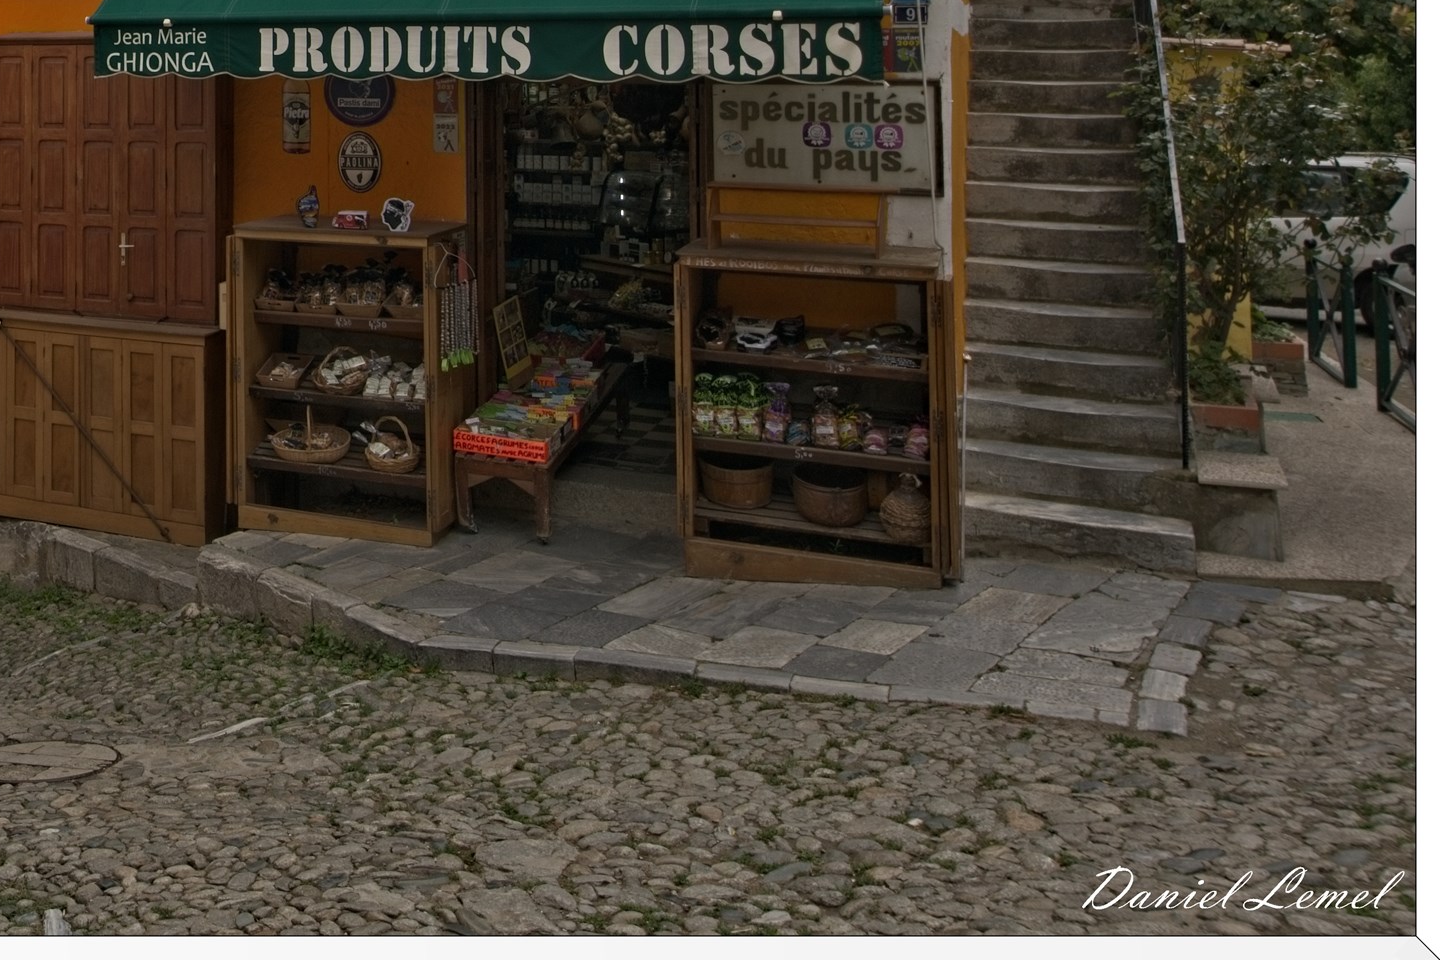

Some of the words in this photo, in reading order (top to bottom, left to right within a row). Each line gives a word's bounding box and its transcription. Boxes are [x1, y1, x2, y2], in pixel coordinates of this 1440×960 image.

[905, 7, 916, 21] 9
[113, 28, 155, 46] Jean
[157, 28, 208, 46] Marie
[258, 25, 532, 76] PRODUITS
[603, 21, 864, 77] CORSES
[106, 51, 215, 73] GHIONGA
[719, 91, 927, 131] spécialités
[340, 157, 379, 168] PAOLINA
[744, 138, 789, 169] du
[812, 148, 902, 182] pays
